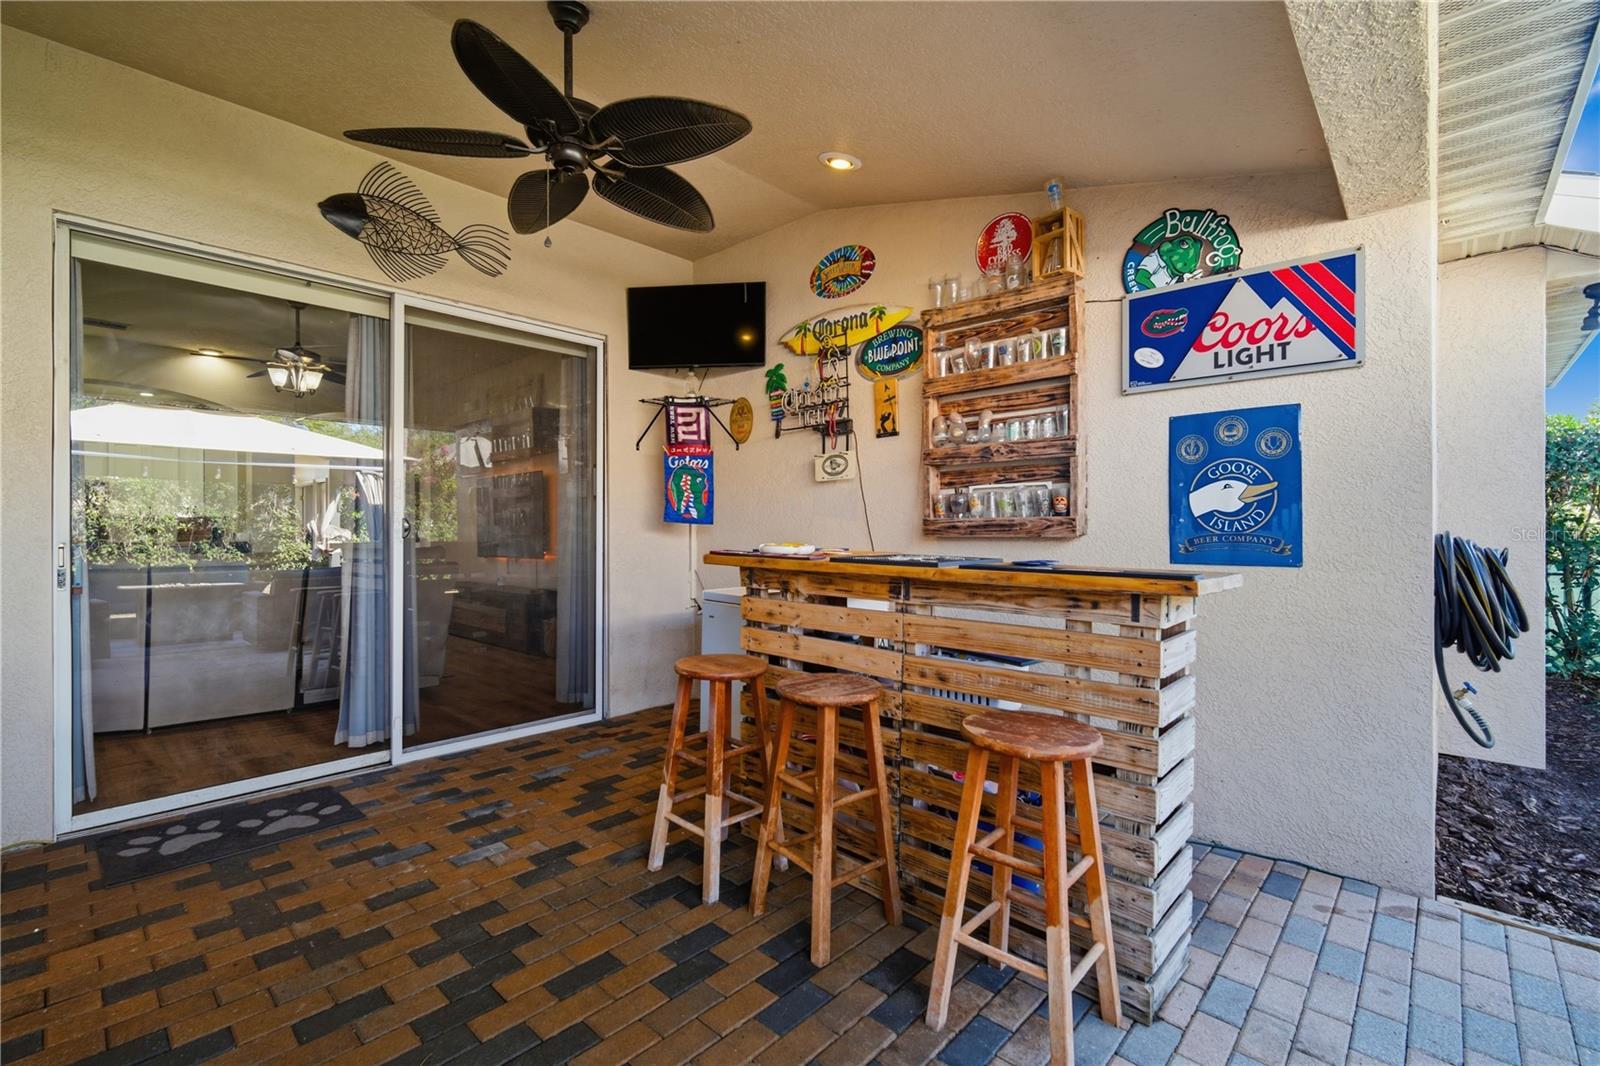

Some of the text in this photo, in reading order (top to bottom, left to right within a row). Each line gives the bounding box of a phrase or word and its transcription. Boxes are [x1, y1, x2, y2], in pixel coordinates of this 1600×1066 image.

[1166, 209, 1241, 266] Bullfrog
[1127, 262, 1139, 294] CREEK
[812, 312, 868, 341] Corona
[872, 328, 913, 348] BREWING
[1193, 312, 1317, 353] Coors
[867, 337, 919, 363] BLUE POINT
[1214, 341, 1291, 369] LIGHT
[876, 357, 910, 372] COMPANY
[668, 455, 709, 469] Gators
[1207, 462, 1262, 480] GOOSE
[1209, 509, 1265, 532] ISLAND
[1193, 535, 1275, 545] BEER COMPANY
